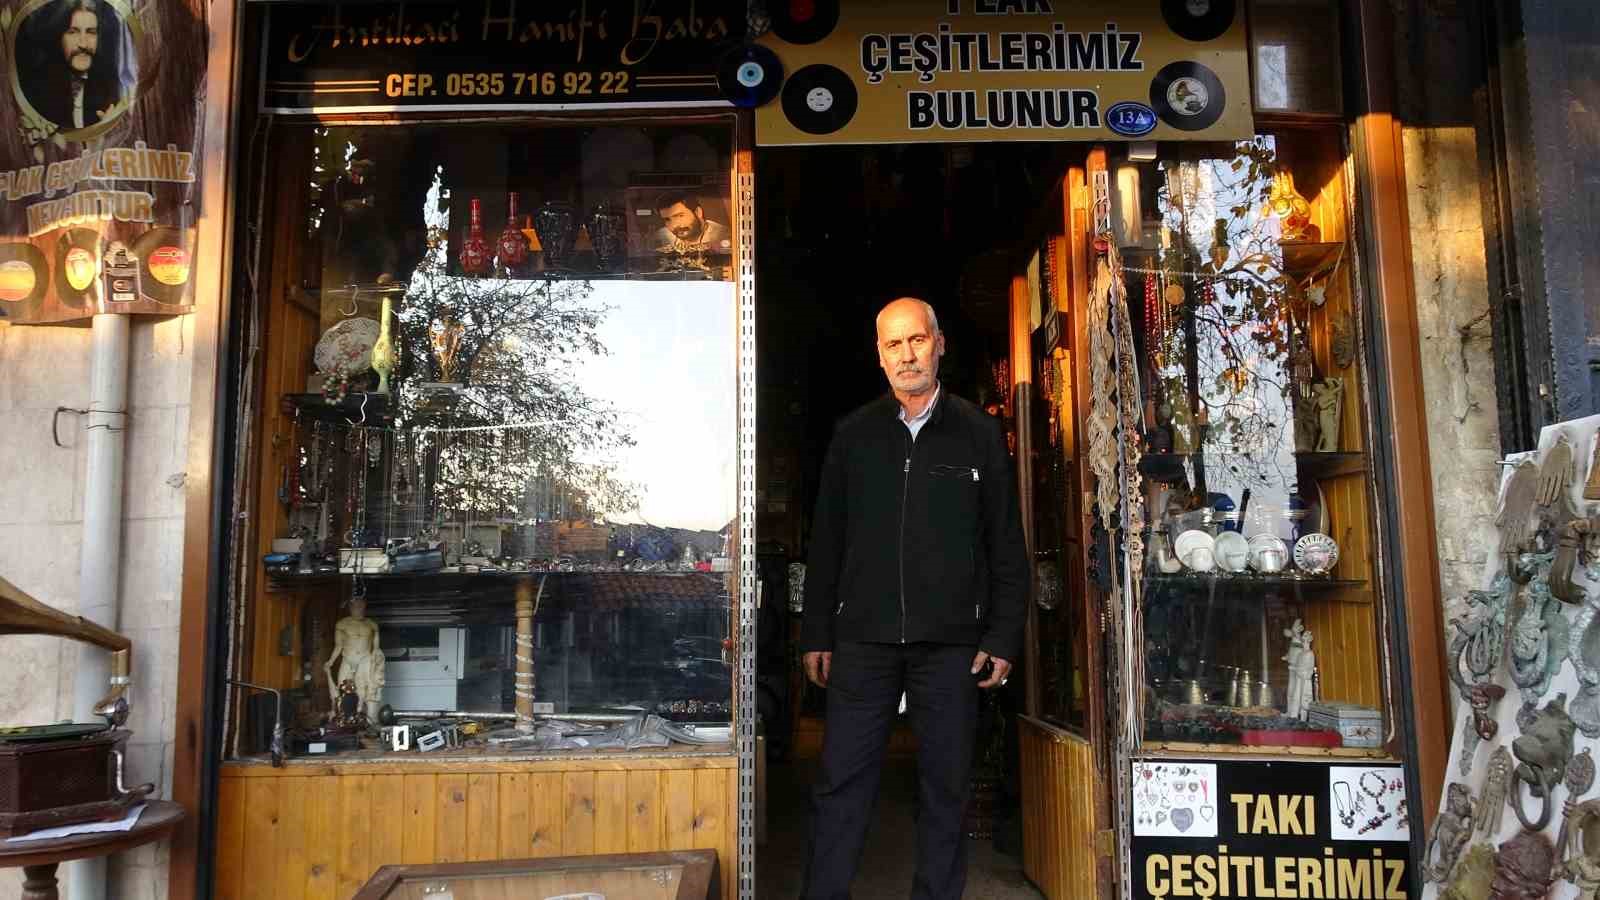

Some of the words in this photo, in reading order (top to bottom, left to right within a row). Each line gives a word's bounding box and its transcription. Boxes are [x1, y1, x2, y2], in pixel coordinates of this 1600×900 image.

[860, 22, 1144, 84] ÇEŞİTLERİMİZ
[385, 73, 437, 97] CEP.
[446, 73, 504, 96] 0535
[512, 72, 556, 95] 716
[563, 72, 592, 95] 92
[600, 71, 629, 94] 22
[908, 89, 1101, 129] BULUNUR
[1119, 111, 1147, 124] 13A
[1230, 793, 1315, 835] TAKI
[1146, 844, 1407, 900] ÇEŞİTLERİMİZ
